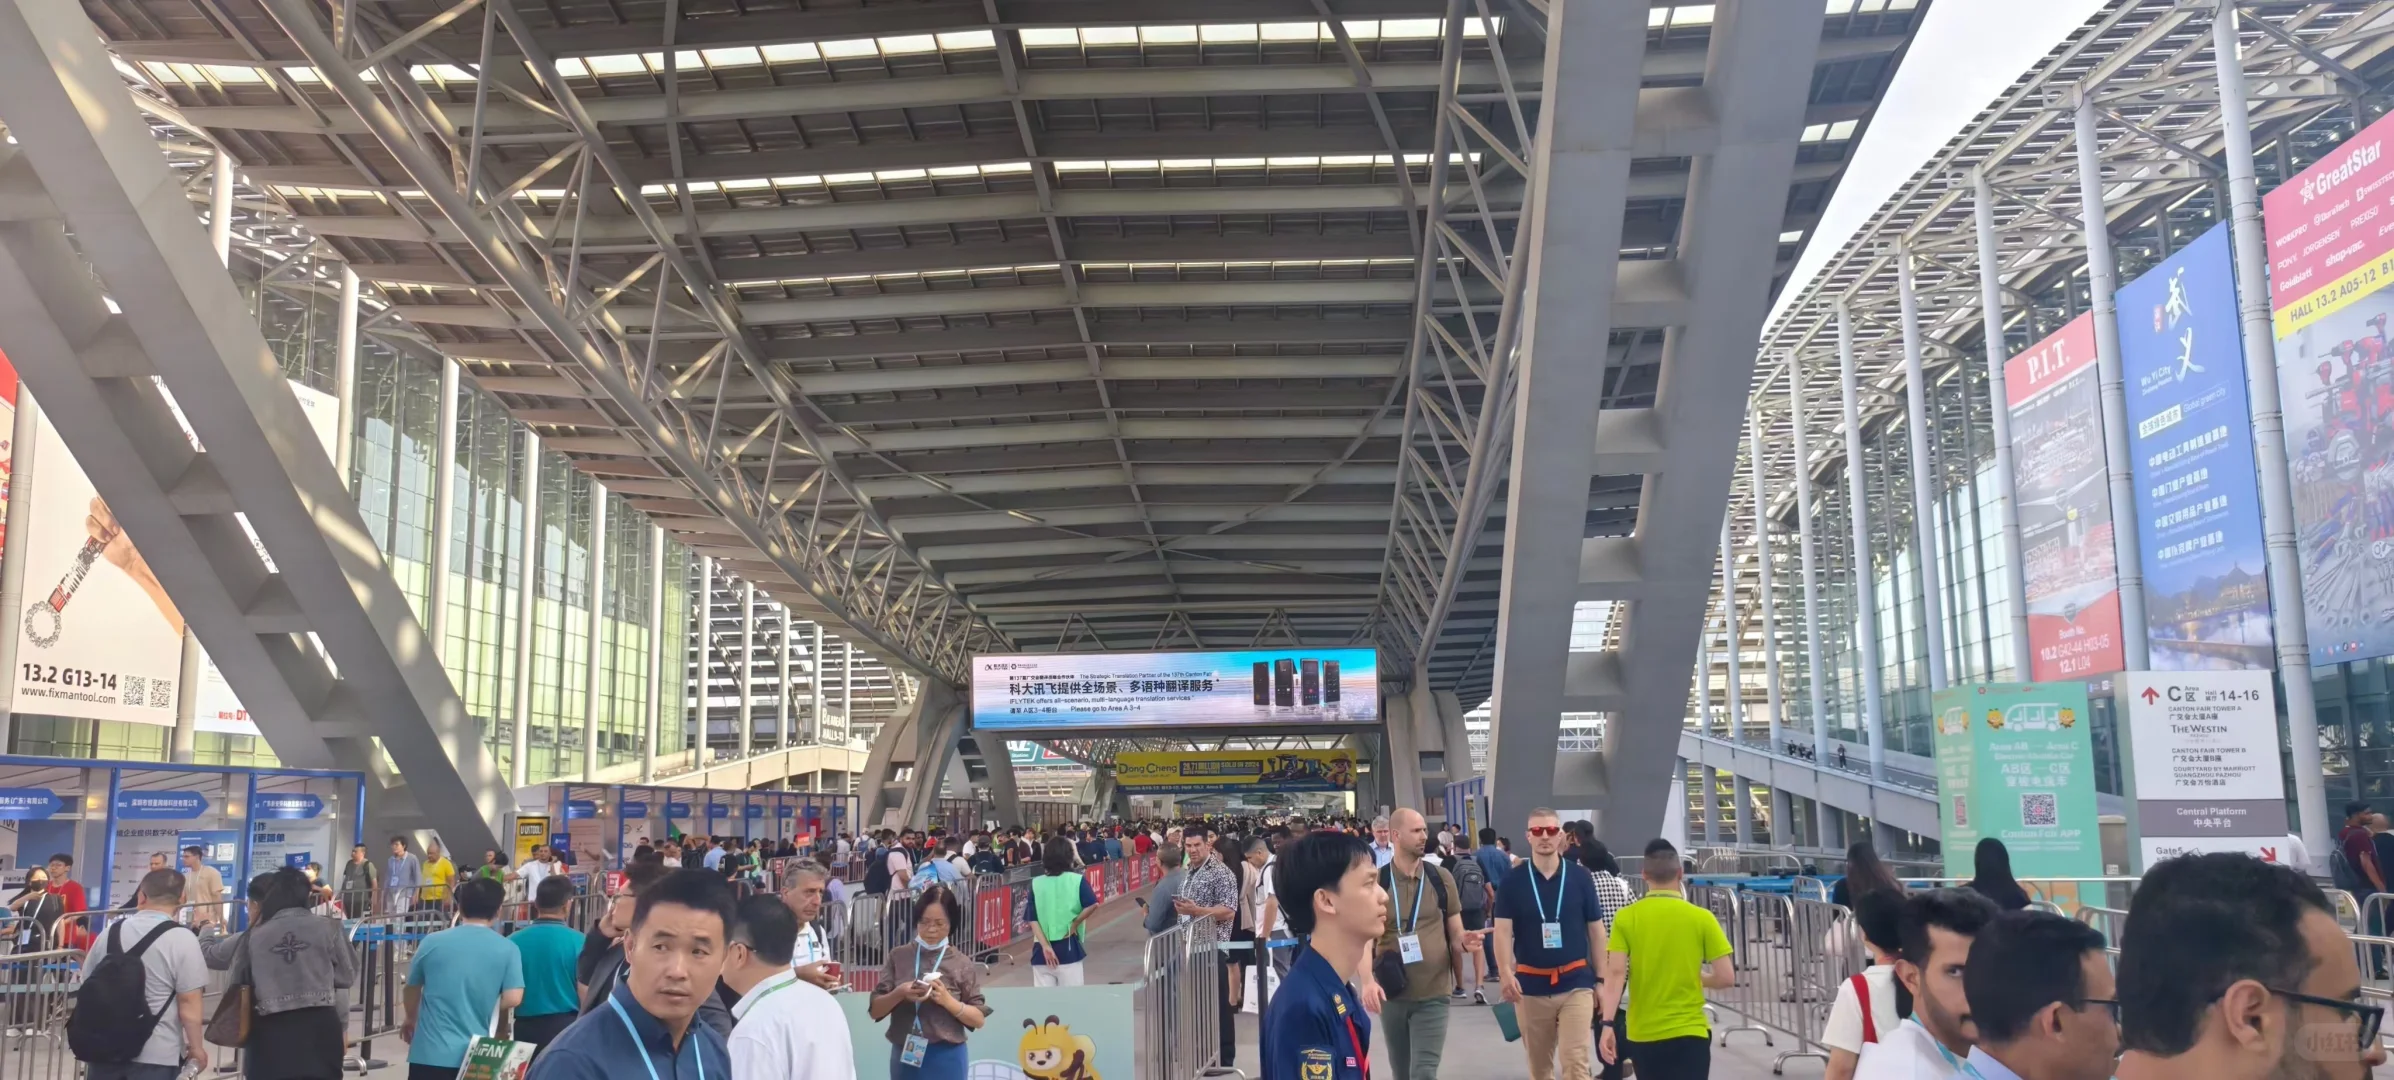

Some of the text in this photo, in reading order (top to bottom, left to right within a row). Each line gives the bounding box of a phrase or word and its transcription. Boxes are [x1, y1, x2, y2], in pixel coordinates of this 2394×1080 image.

[2316, 140, 2381, 195] GreatStar
[2279, 268, 2313, 292] Goldblatt
[2290, 301, 2313, 322] HALL
[2316, 289, 2337, 308] 13.2
[2340, 268, 2377, 299] A05-12
[2026, 338, 2070, 385] P.I.T.
[2141, 376, 2151, 387] Wu
[2158, 365, 2171, 377] City
[2040, 645, 2057, 661] 10.2
[2059, 659, 2076, 674] 12.1
[23, 663, 117, 690] 13.2 G13-14
[21, 687, 116, 704] www.fixmantool.com
[1091, 696, 1135, 704] multi-language
[2167, 685, 2182, 702] C
[2185, 691, 2196, 702] 区
[2219, 689, 2260, 701] 14-16
[2170, 724, 2227, 733] THE WESTIN
[1118, 763, 1145, 774] Dong
[1146, 763, 1178, 774] Cheng
[2176, 807, 2247, 816] Central Platform
[2193, 818, 2232, 828] 中央平台
[2001, 829, 2037, 839] Canton
[2059, 829, 2081, 838] APP
